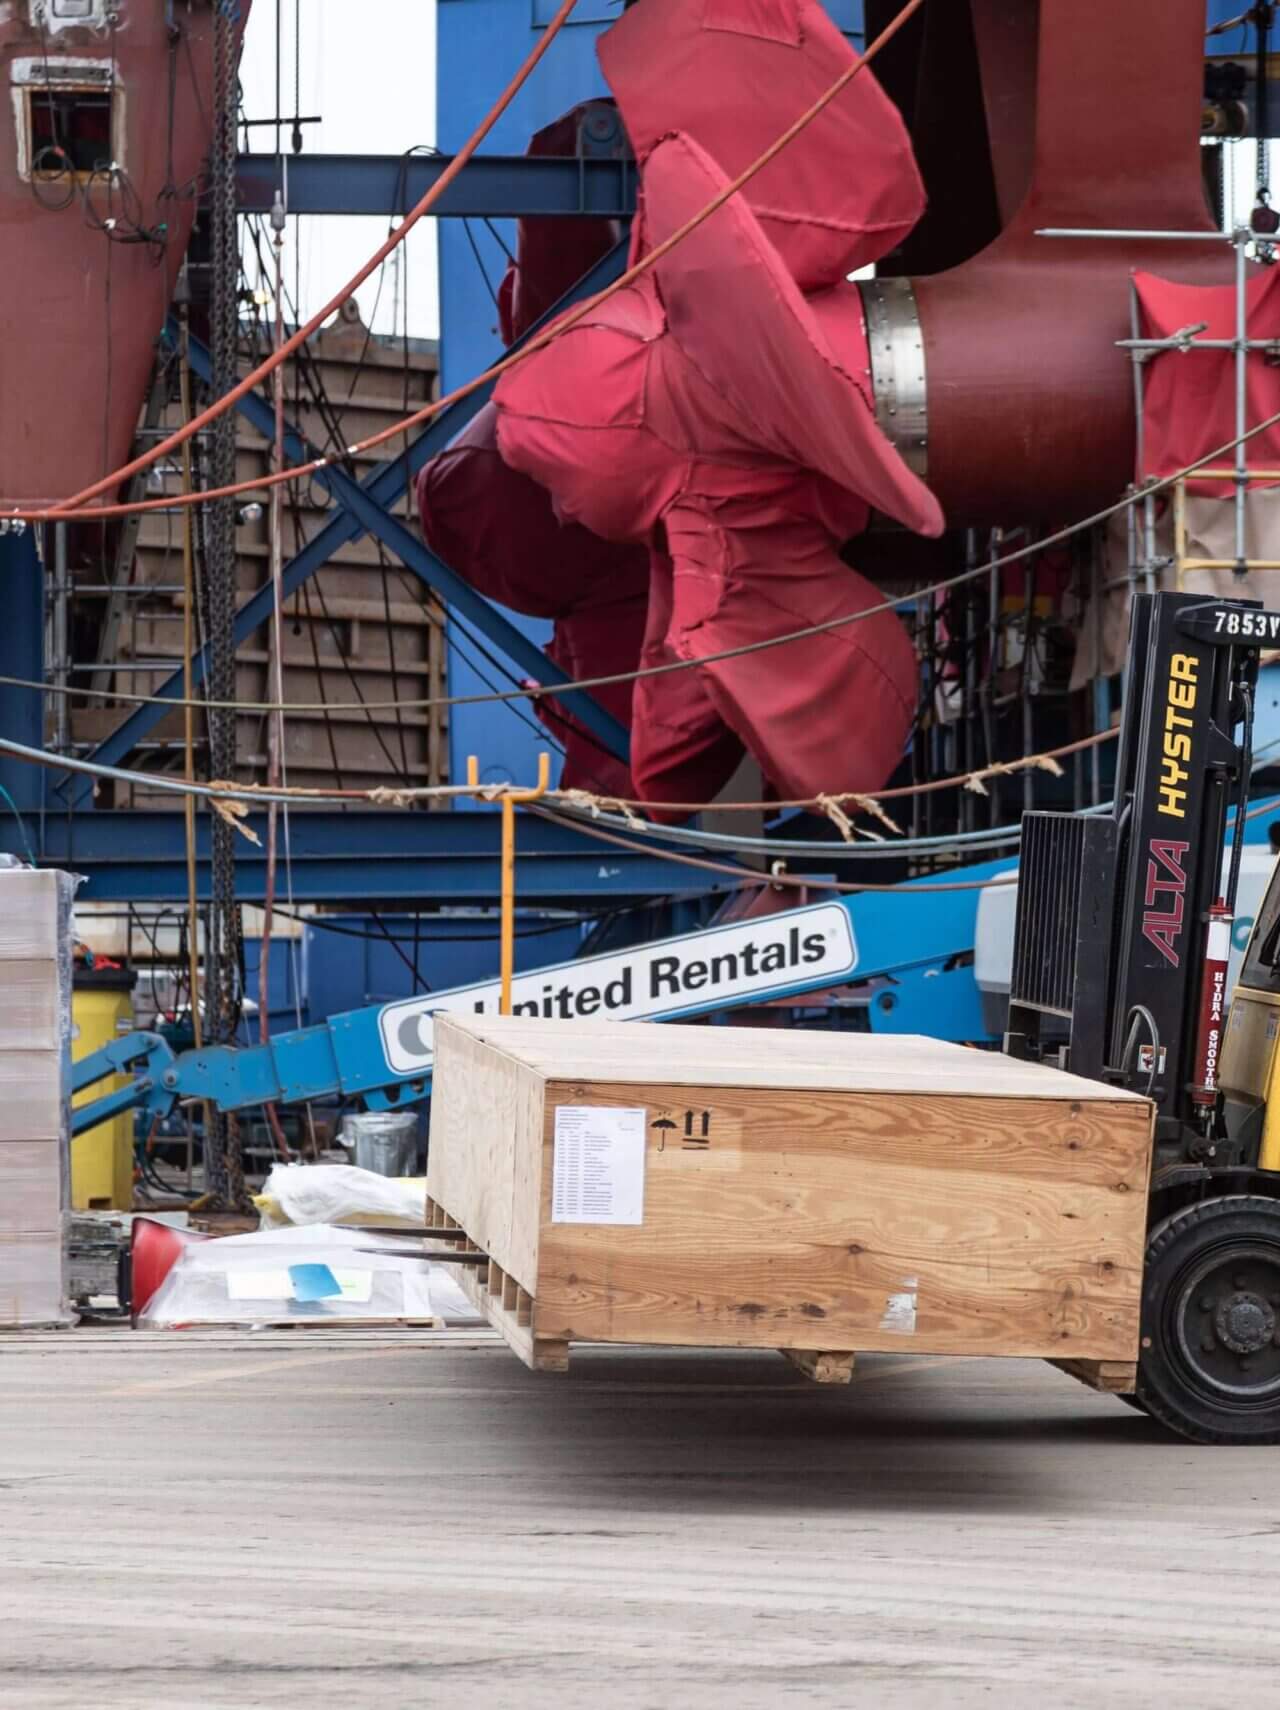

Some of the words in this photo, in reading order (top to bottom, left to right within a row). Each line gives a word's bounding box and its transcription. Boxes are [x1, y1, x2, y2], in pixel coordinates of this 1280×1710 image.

[1214, 611, 1280, 639] 7853V
[1157, 653, 1199, 818] HYSTER
[1142, 839, 1190, 969] ALTA
[650, 926, 826, 998] Rentals
[1210, 971, 1224, 1021] HYDRA
[1204, 1029, 1219, 1089] SMOOTH
